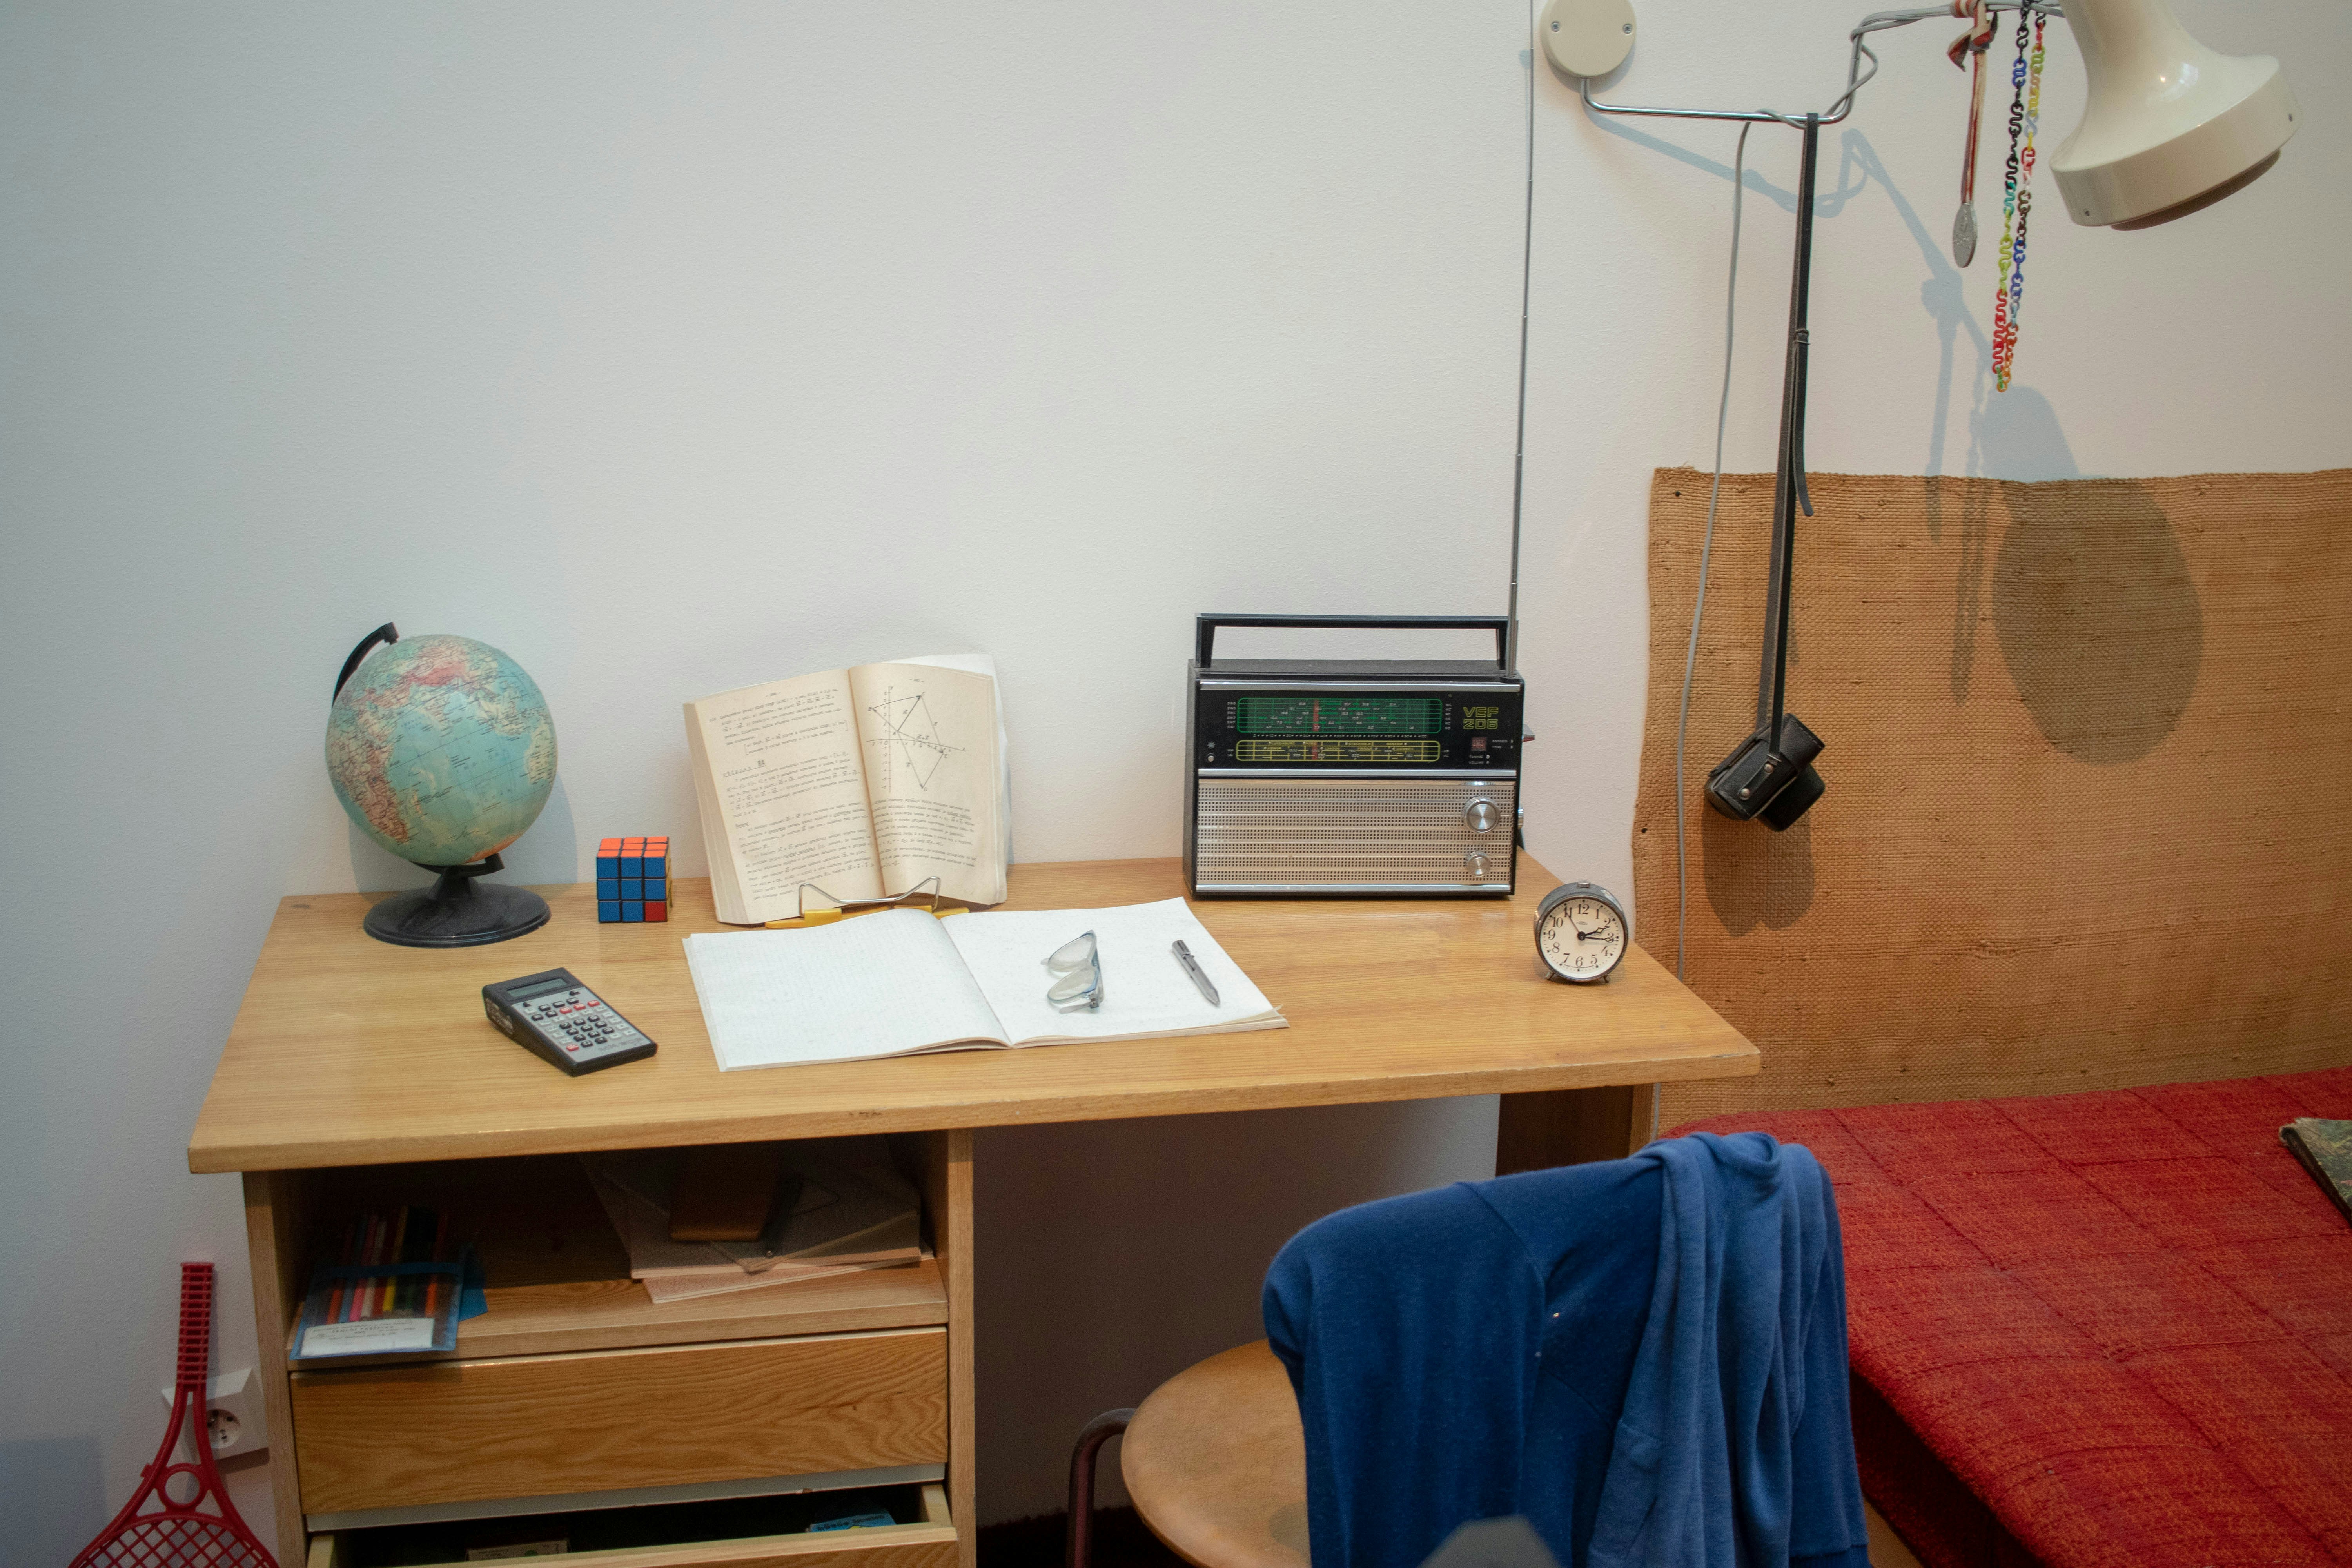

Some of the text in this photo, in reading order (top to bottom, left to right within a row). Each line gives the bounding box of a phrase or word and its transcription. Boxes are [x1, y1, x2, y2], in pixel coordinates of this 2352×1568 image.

[1463, 707, 1499, 717] VEF
[1463, 719, 1499, 729] 206
[1564, 907, 1572, 918] 11
[1577, 904, 1589, 914] 12
[1595, 909, 1600, 919] 1
[1552, 917, 1563, 928] 10
[1604, 918, 1611, 929] 2
[1548, 929, 1555, 940] 9
[1606, 933, 1614, 943] 3
[1552, 942, 1560, 953] 8
[1601, 946, 1608, 956] 4
[1563, 953, 1570, 963] 7
[1576, 956, 1583, 967] 6
[1590, 954, 1597, 964] 5
